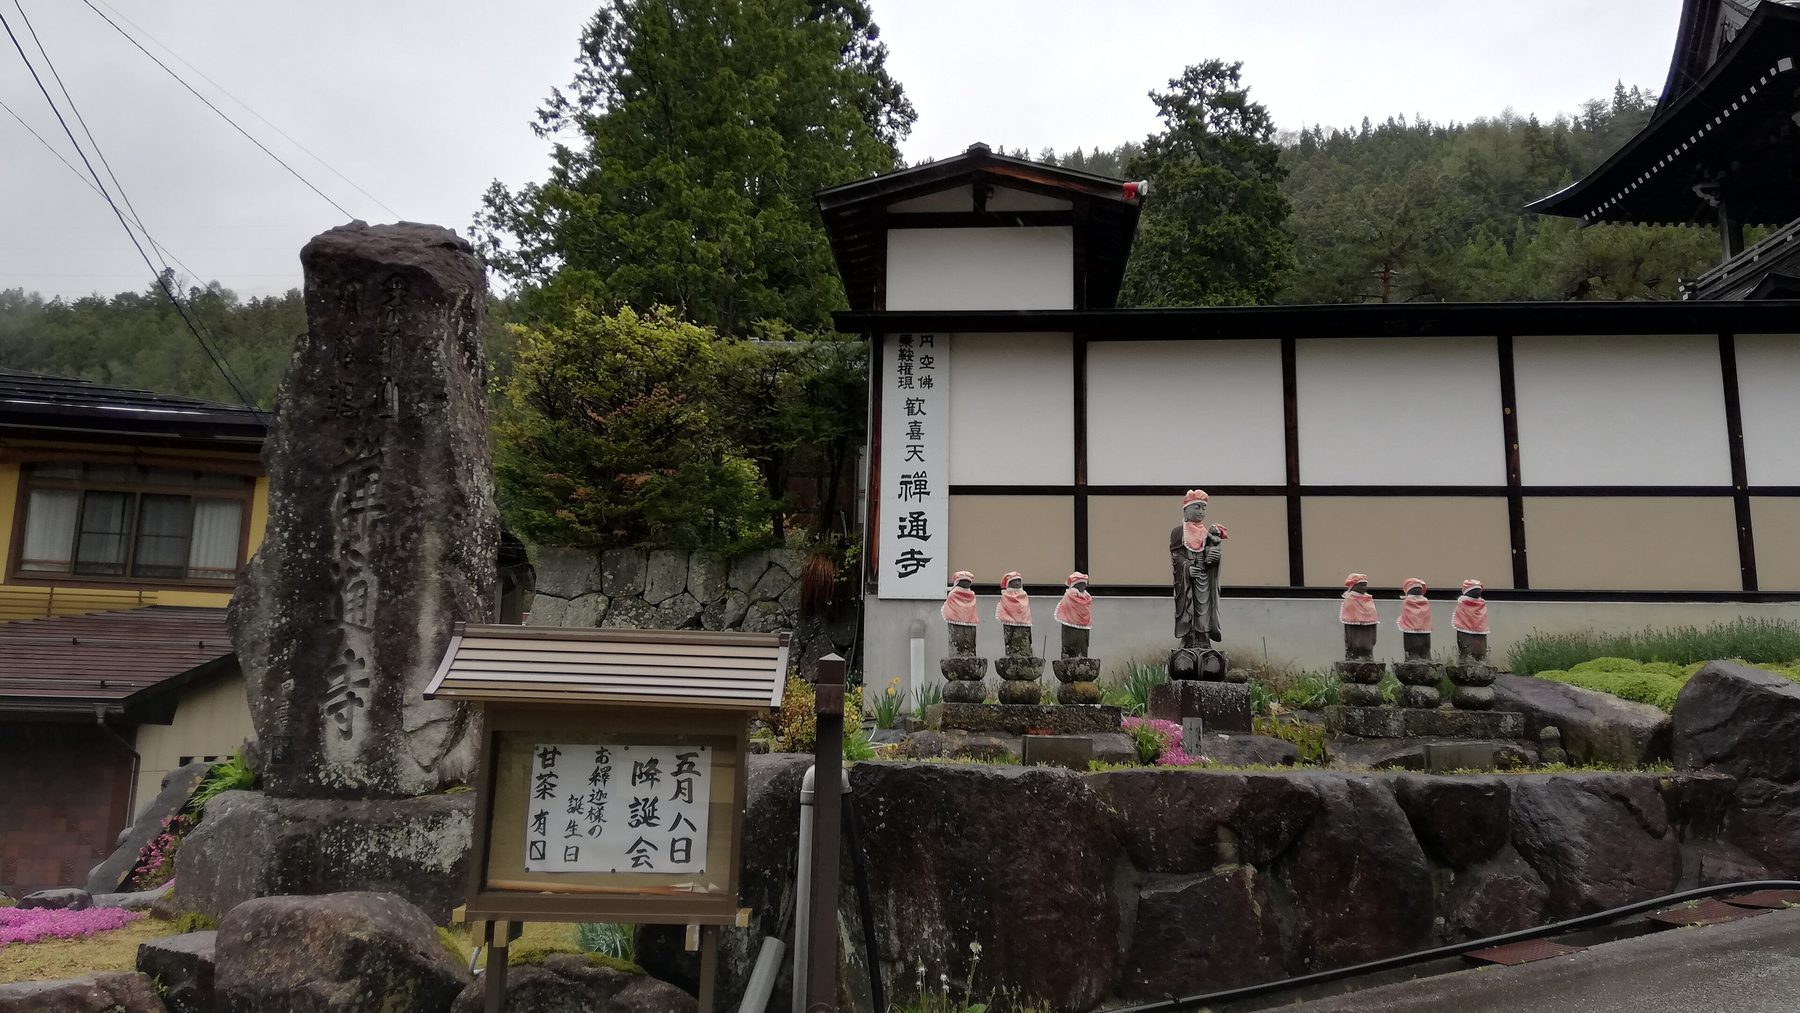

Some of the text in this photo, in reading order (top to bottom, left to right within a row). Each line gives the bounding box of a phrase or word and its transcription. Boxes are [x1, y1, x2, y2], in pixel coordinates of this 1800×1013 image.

[624, 756, 663, 869] 降誕会
[668, 752, 702, 864] 五月八日
